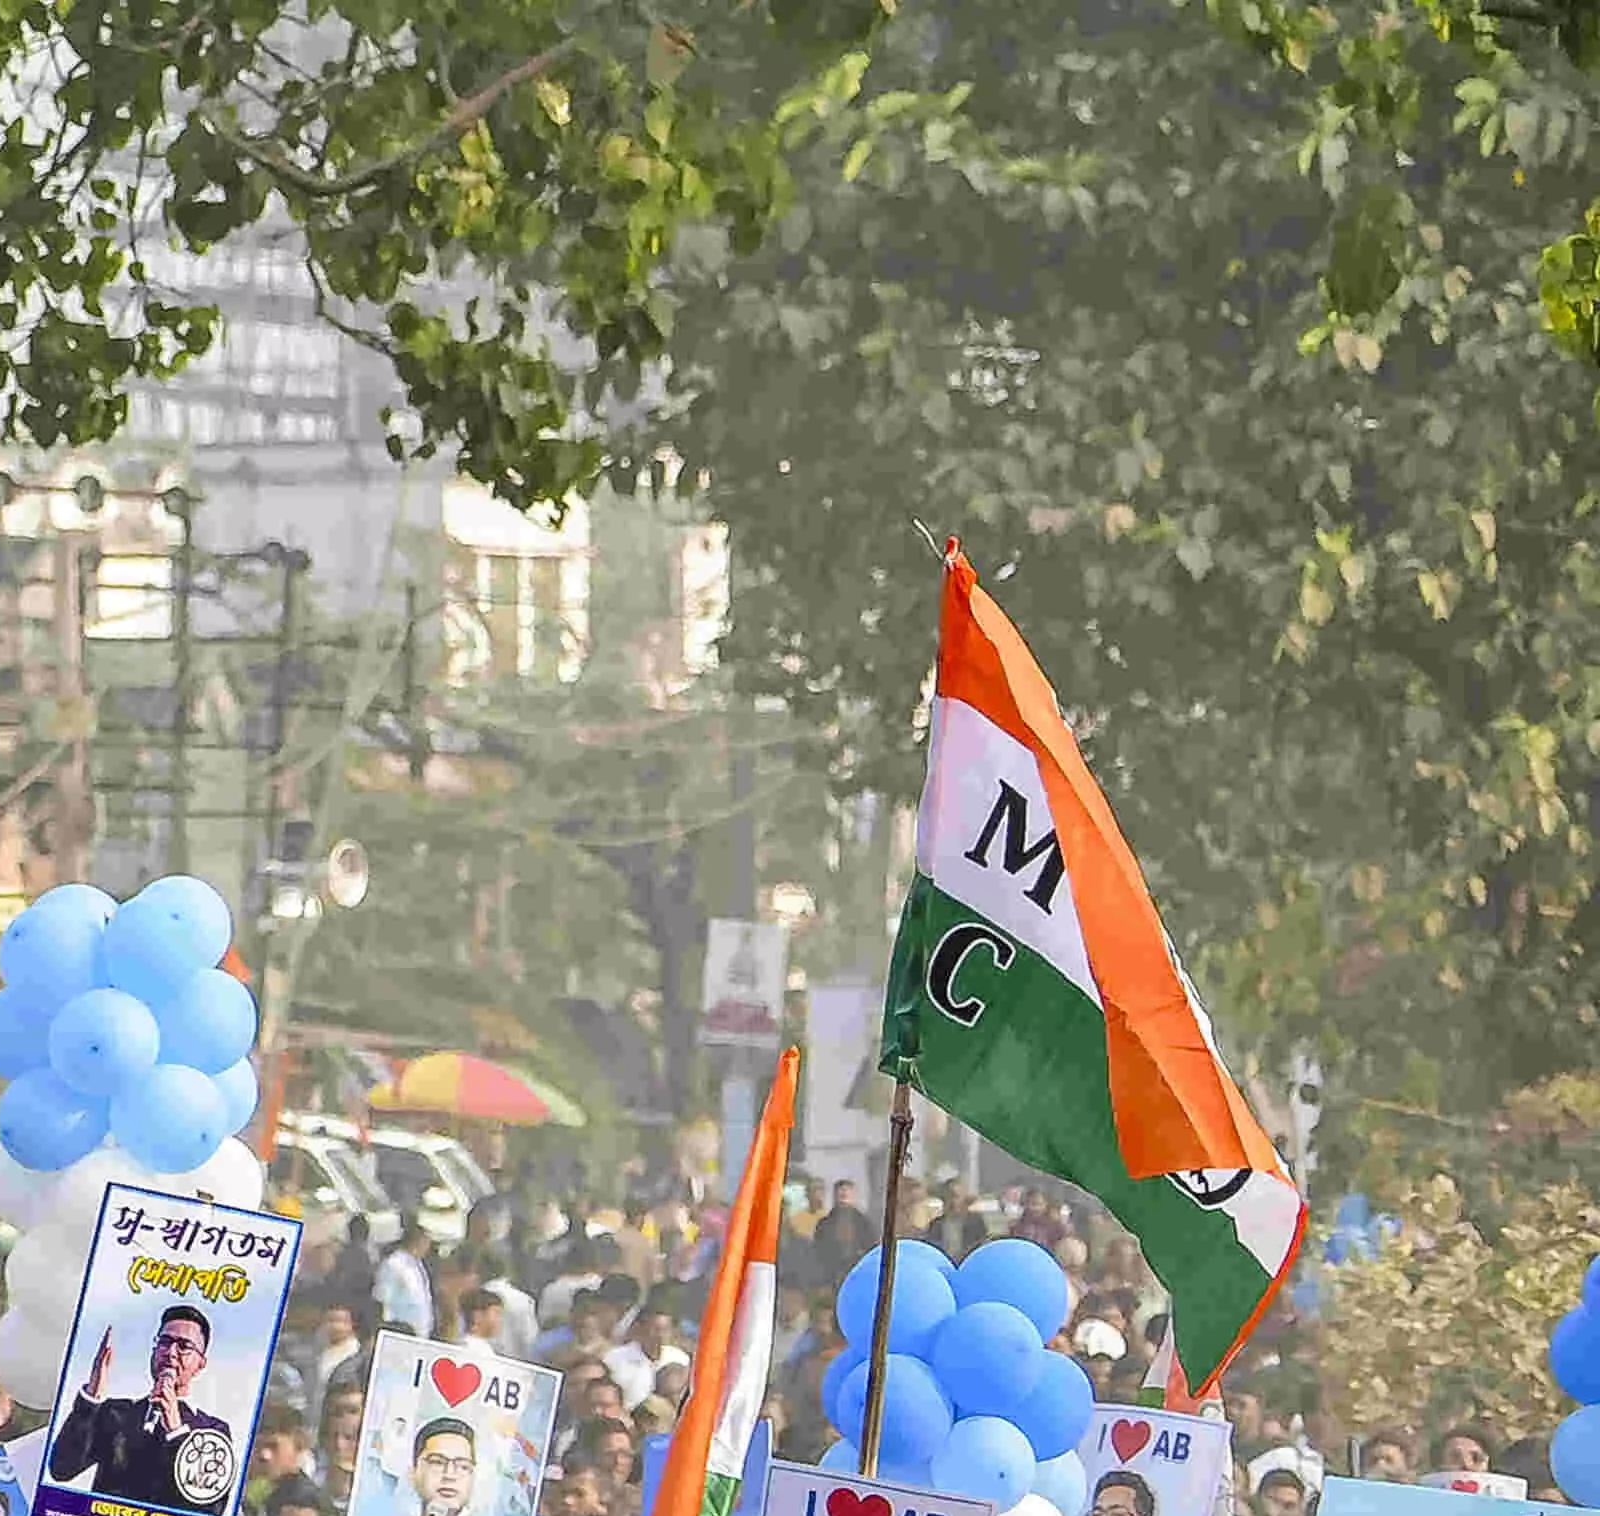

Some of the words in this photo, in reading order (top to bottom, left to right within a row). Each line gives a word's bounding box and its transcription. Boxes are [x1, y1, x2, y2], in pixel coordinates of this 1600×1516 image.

[964, 778, 1069, 916] M
[929, 925, 1013, 1026] C
[414, 1359, 423, 1387] I
[484, 1377, 522, 1410] AB
[1152, 1430, 1191, 1461] AB
